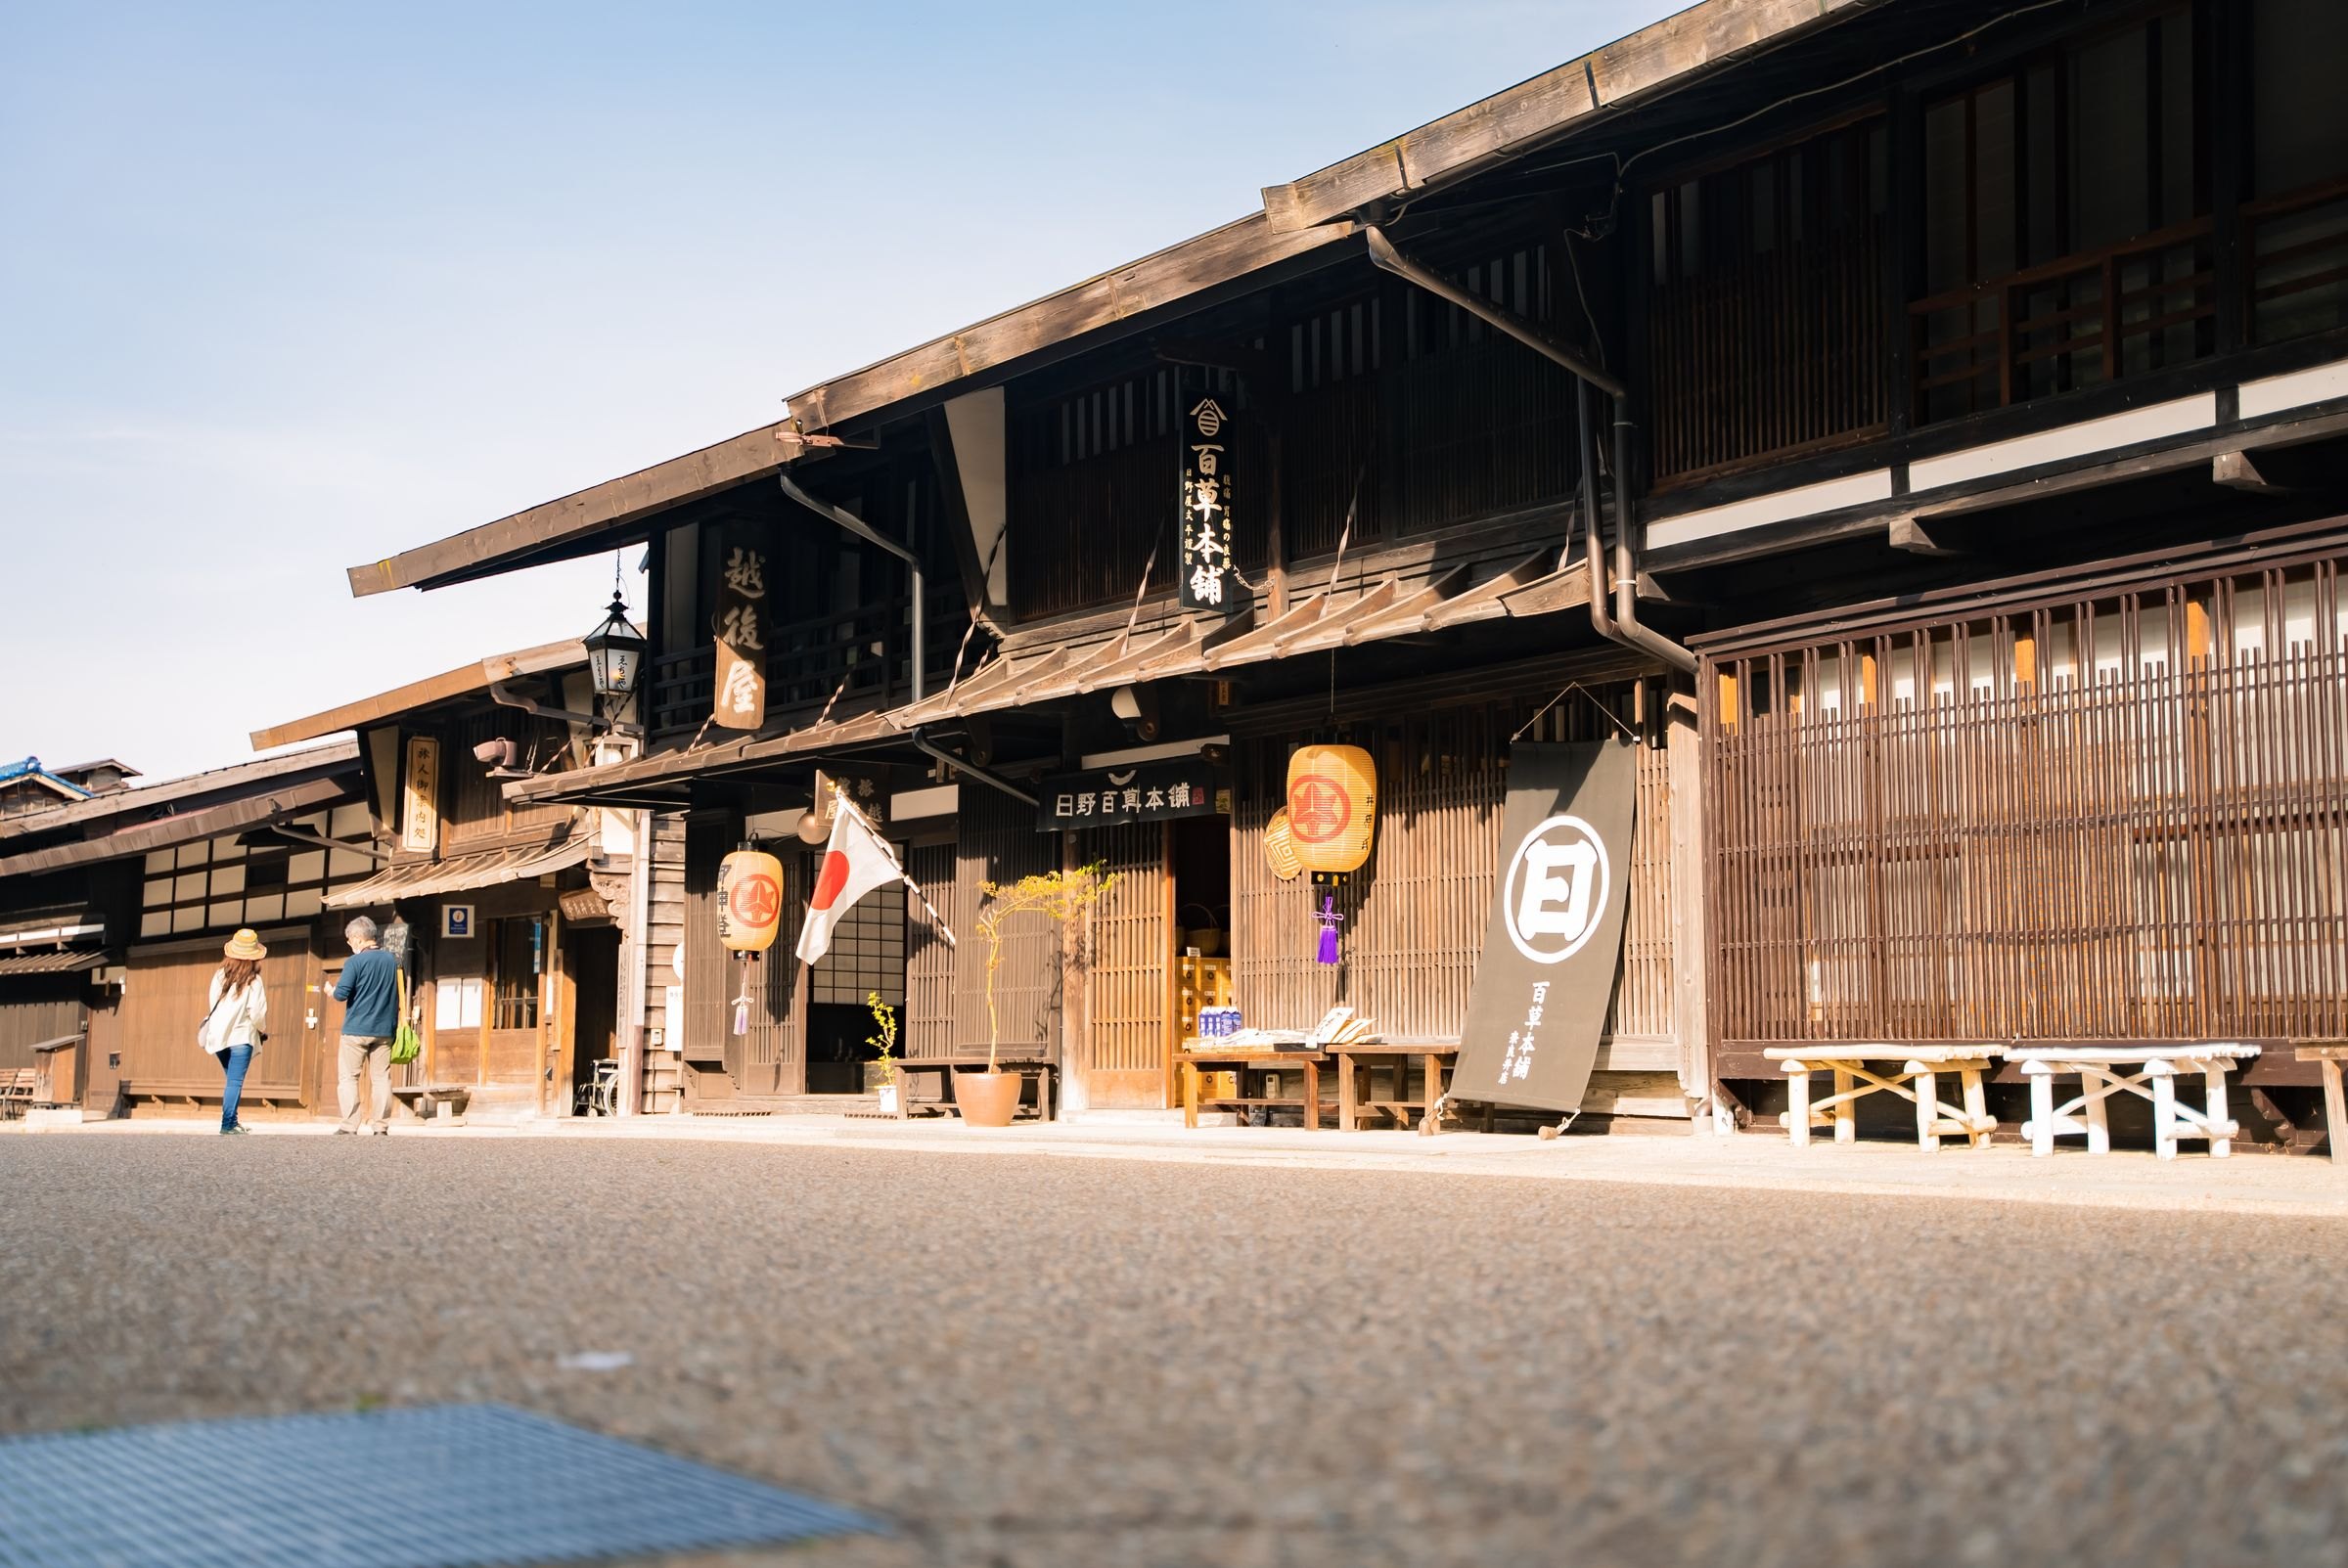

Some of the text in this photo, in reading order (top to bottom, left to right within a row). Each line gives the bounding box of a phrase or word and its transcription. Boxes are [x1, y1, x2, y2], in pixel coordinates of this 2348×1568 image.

[721, 547, 766, 713] 越後屋
[1498, 1030, 1518, 1085] 奈良井店
